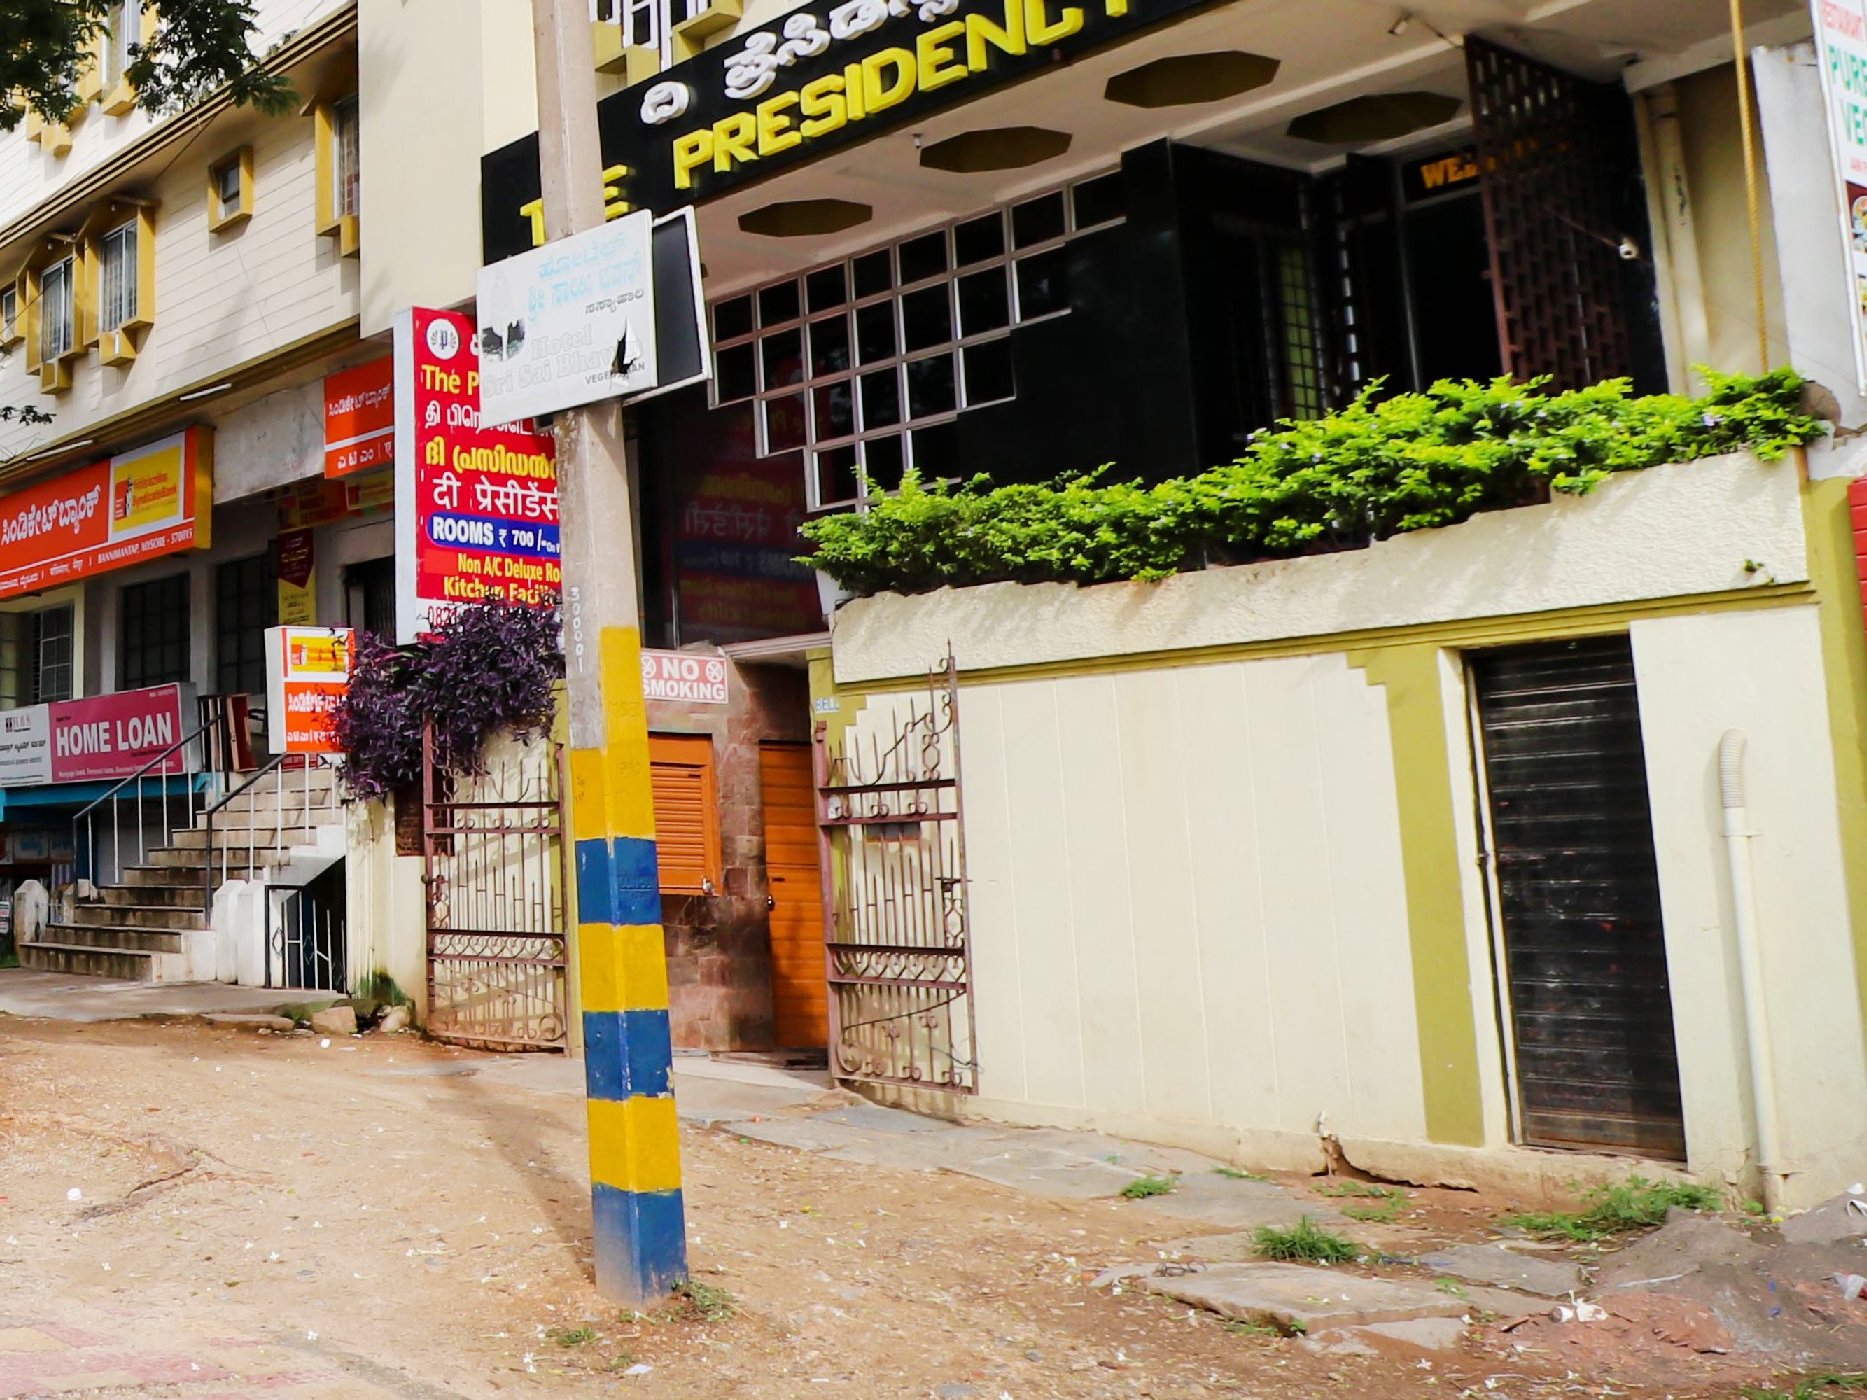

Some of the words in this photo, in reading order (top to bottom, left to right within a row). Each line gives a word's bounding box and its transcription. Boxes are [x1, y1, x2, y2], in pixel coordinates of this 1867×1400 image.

[520, 164, 630, 246] TE
[421, 364, 461, 394] The
[432, 471, 462, 510] दी
[432, 516, 494, 546] ROOMS
[511, 529, 534, 547] 700
[458, 552, 481, 575] Non
[484, 555, 503, 578] A/C
[505, 557, 543, 583] Deluxe
[661, 658, 700, 681] NO
[643, 678, 725, 700] SMOKING
[56, 721, 111, 757] HOME
[117, 711, 172, 750] LOAN
